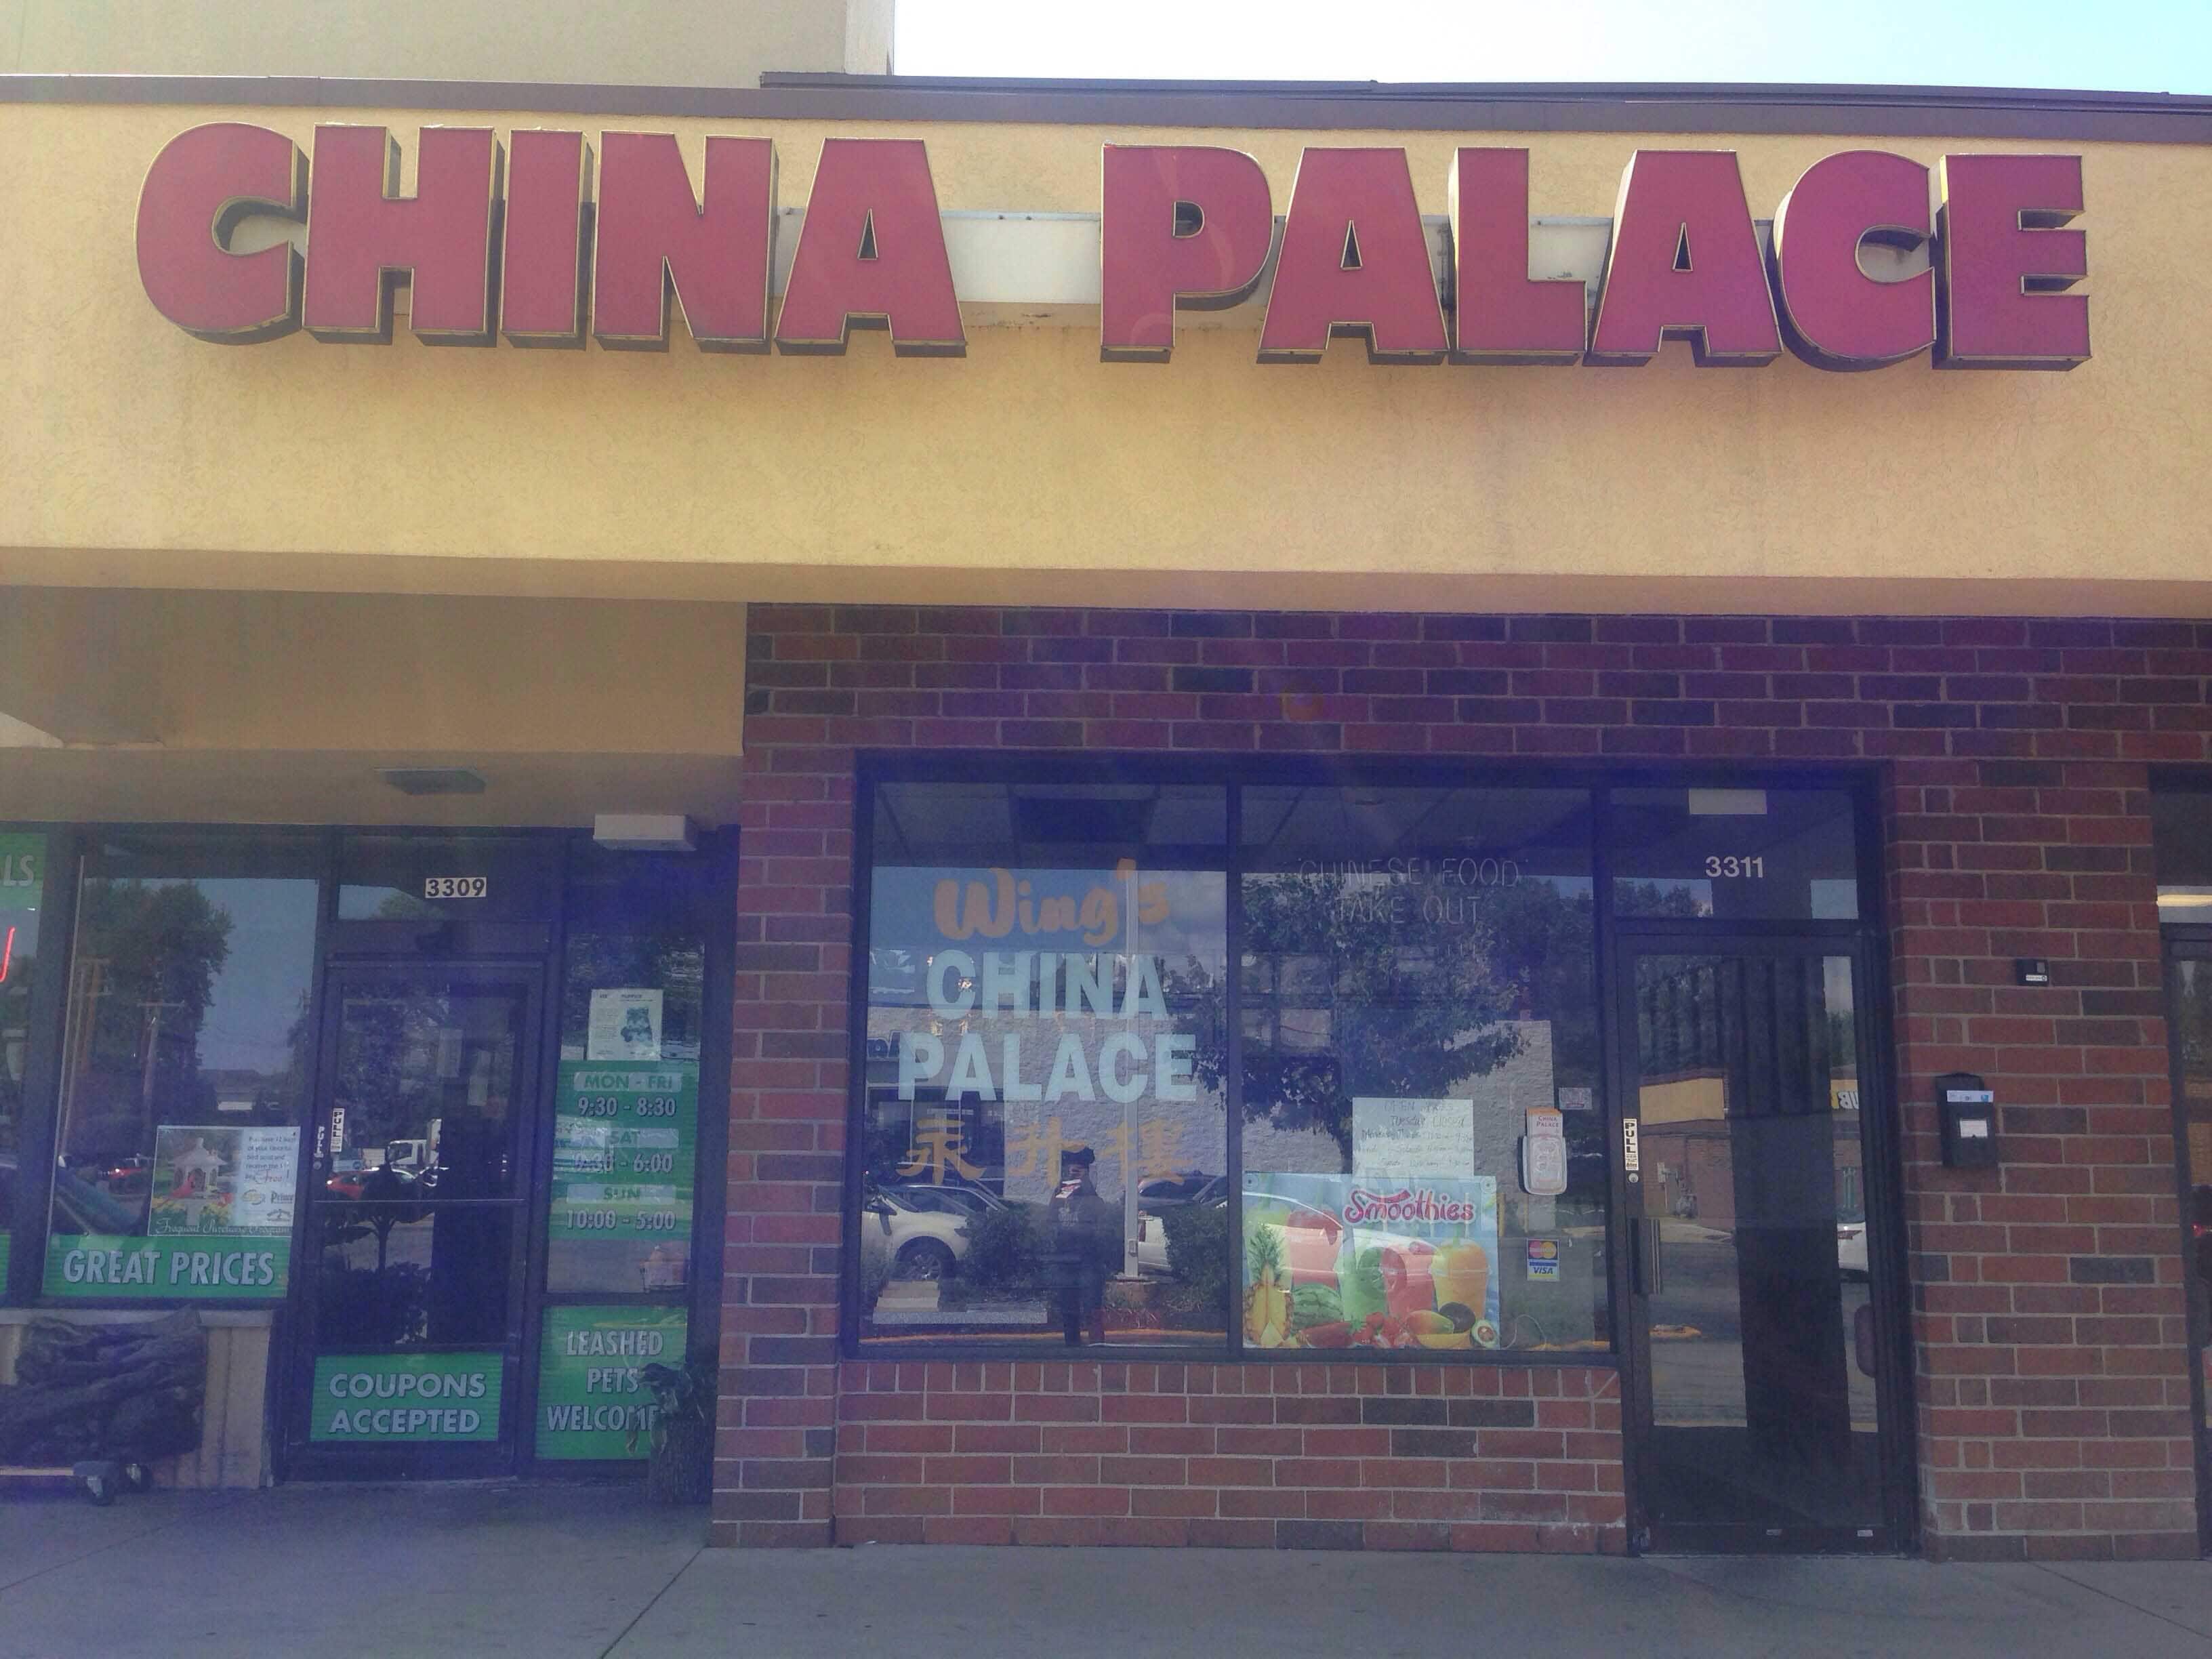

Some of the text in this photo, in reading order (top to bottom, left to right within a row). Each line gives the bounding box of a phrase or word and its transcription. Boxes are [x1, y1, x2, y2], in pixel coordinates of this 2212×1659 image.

[135, 121, 2090, 371] CHINA PALACE
[1442, 857, 1519, 887] FOOD
[1706, 856, 1763, 878] 3311
[427, 878, 485, 897] 3309
[933, 858, 1170, 947] Wing's
[1334, 895, 1481, 925] TAKE OUT
[926, 949, 1168, 1020] CHINA
[897, 1032, 1197, 1103] PALACE
[585, 1075, 629, 1089] MON
[648, 1075, 672, 1089] FRI
[578, 1097, 618, 1117] 9:30
[636, 1097, 676, 1118] 8:30
[333, 1111, 343, 1137] PULL
[609, 1130, 641, 1145] SAT
[1625, 1122, 1637, 1153] PULL
[634, 1153, 673, 1173] 6:00
[603, 1187, 640, 1200] SUN
[1344, 1187, 1476, 1223] Smoothies
[567, 1209, 617, 1229] 10:00
[635, 1210, 676, 1230] 5:00
[63, 1250, 274, 1286] GREAT PRICES
[567, 1330, 663, 1356] LEASHED
[329, 1373, 486, 1399] COUPONS
[586, 1366, 639, 1394] PETS
[328, 1409, 480, 1434] ACCEPTED
